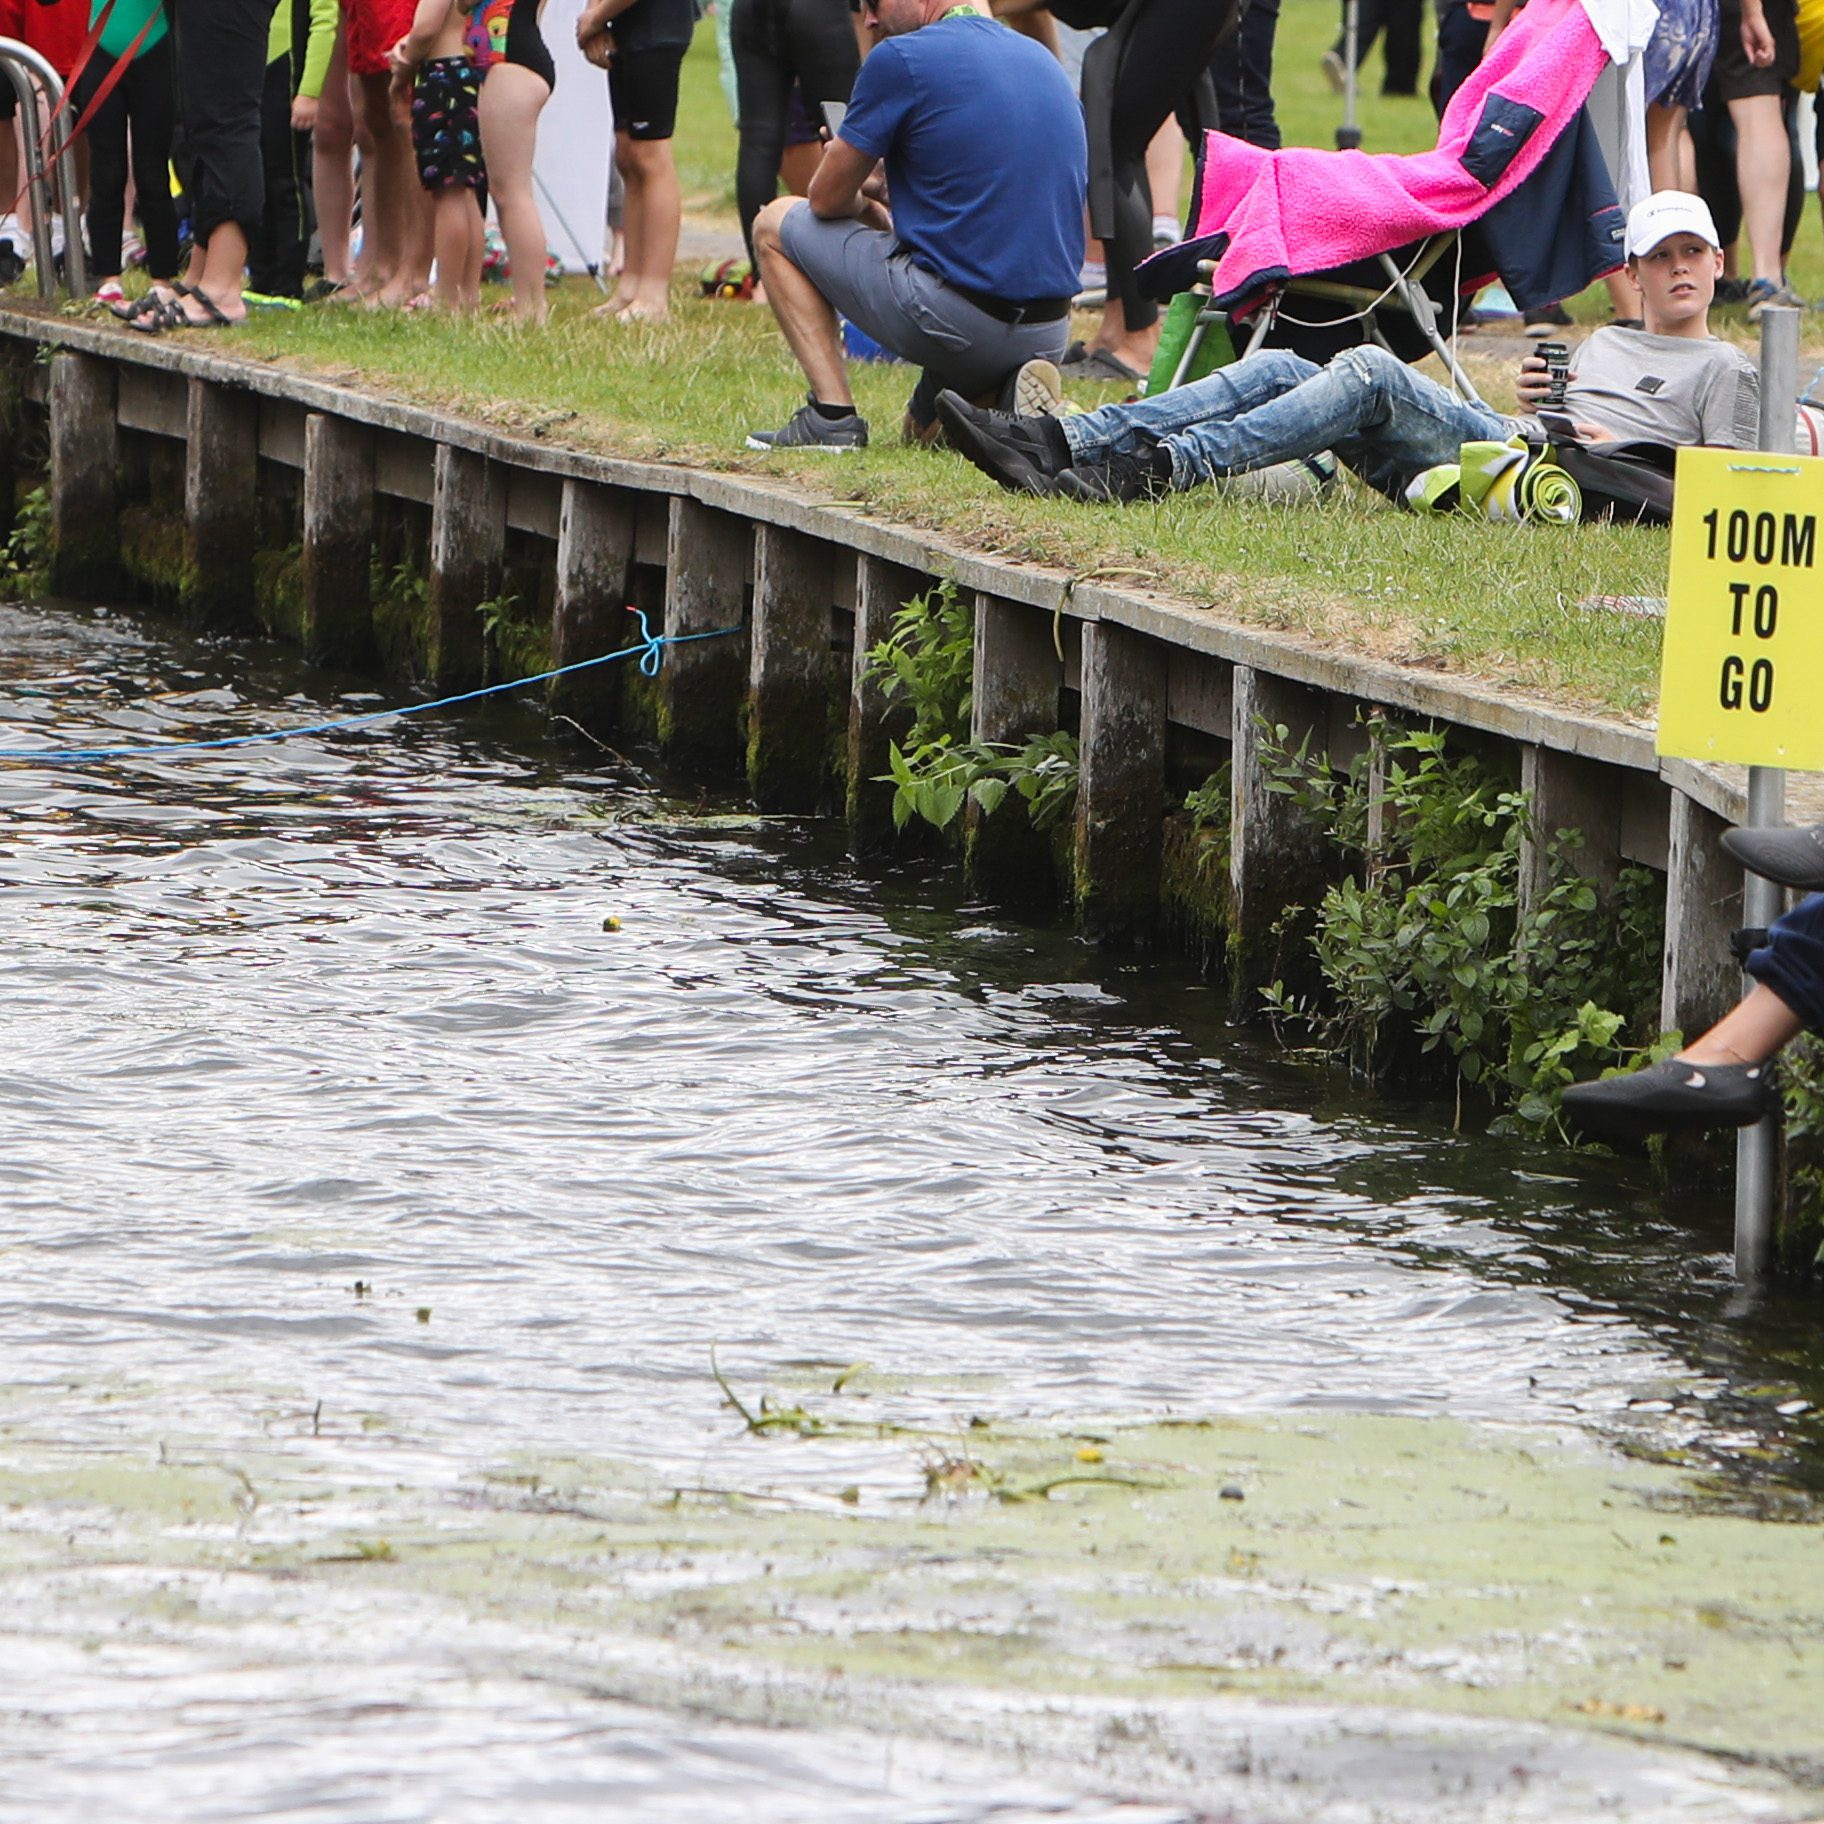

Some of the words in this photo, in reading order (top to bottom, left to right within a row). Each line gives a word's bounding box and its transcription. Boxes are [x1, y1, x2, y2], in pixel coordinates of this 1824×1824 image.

[1702, 508, 1816, 568] 100M
[1728, 584, 1778, 640] TO
[1719, 657, 1774, 715] GO
